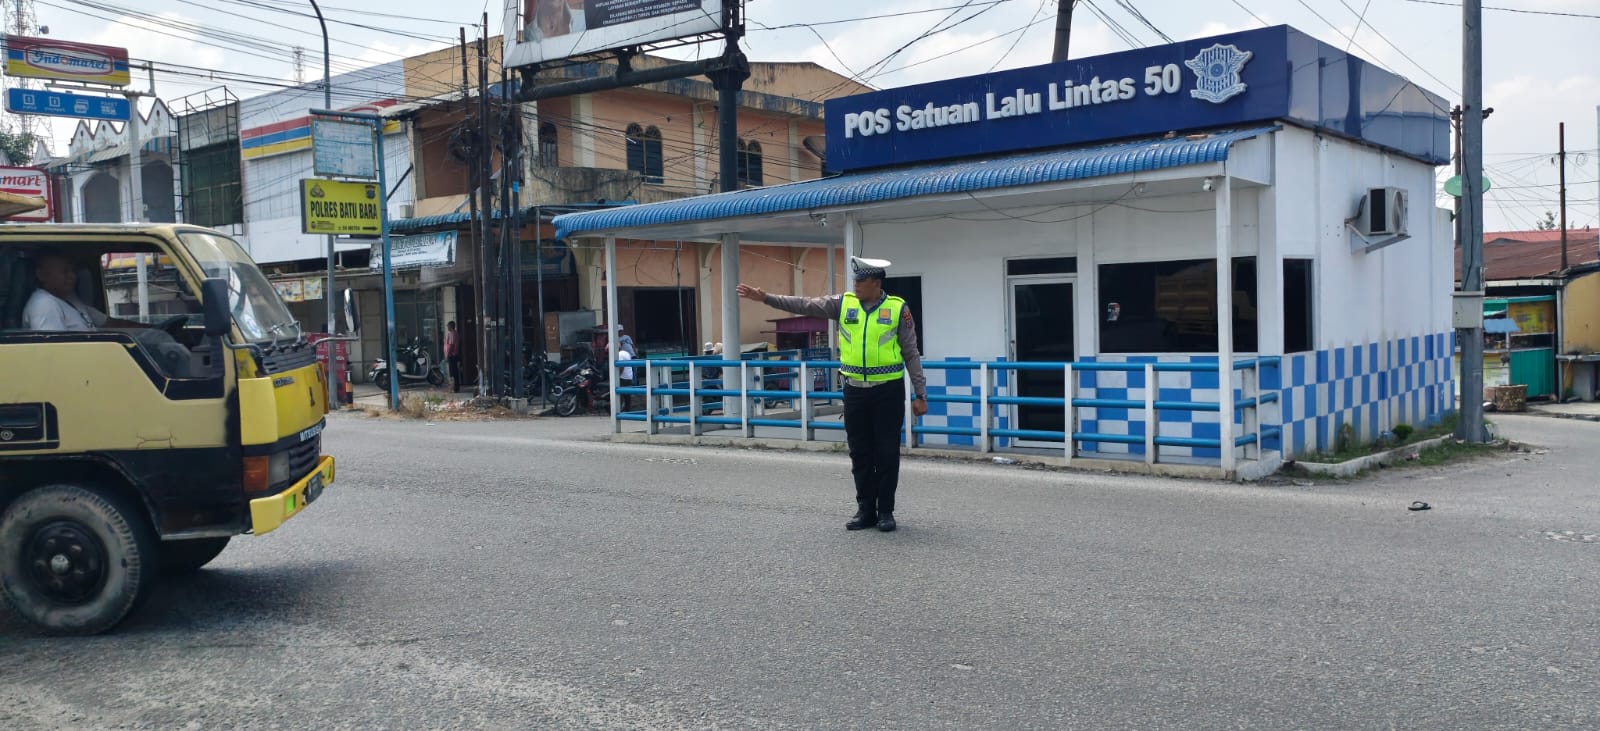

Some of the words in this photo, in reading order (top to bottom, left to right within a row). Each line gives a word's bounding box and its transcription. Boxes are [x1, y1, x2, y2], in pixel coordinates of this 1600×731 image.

[32, 50, 107, 69] Indomaret
[844, 108, 891, 139] POS
[895, 101, 980, 130] Satuan
[985, 88, 1042, 121] Lalu
[1048, 75, 1137, 112] Lintas
[1143, 62, 1182, 97] 50
[0, 175, 41, 187] mart
[310, 201, 338, 218] POLRES
[339, 202, 358, 218] BATU
[359, 203, 378, 219] BARA
